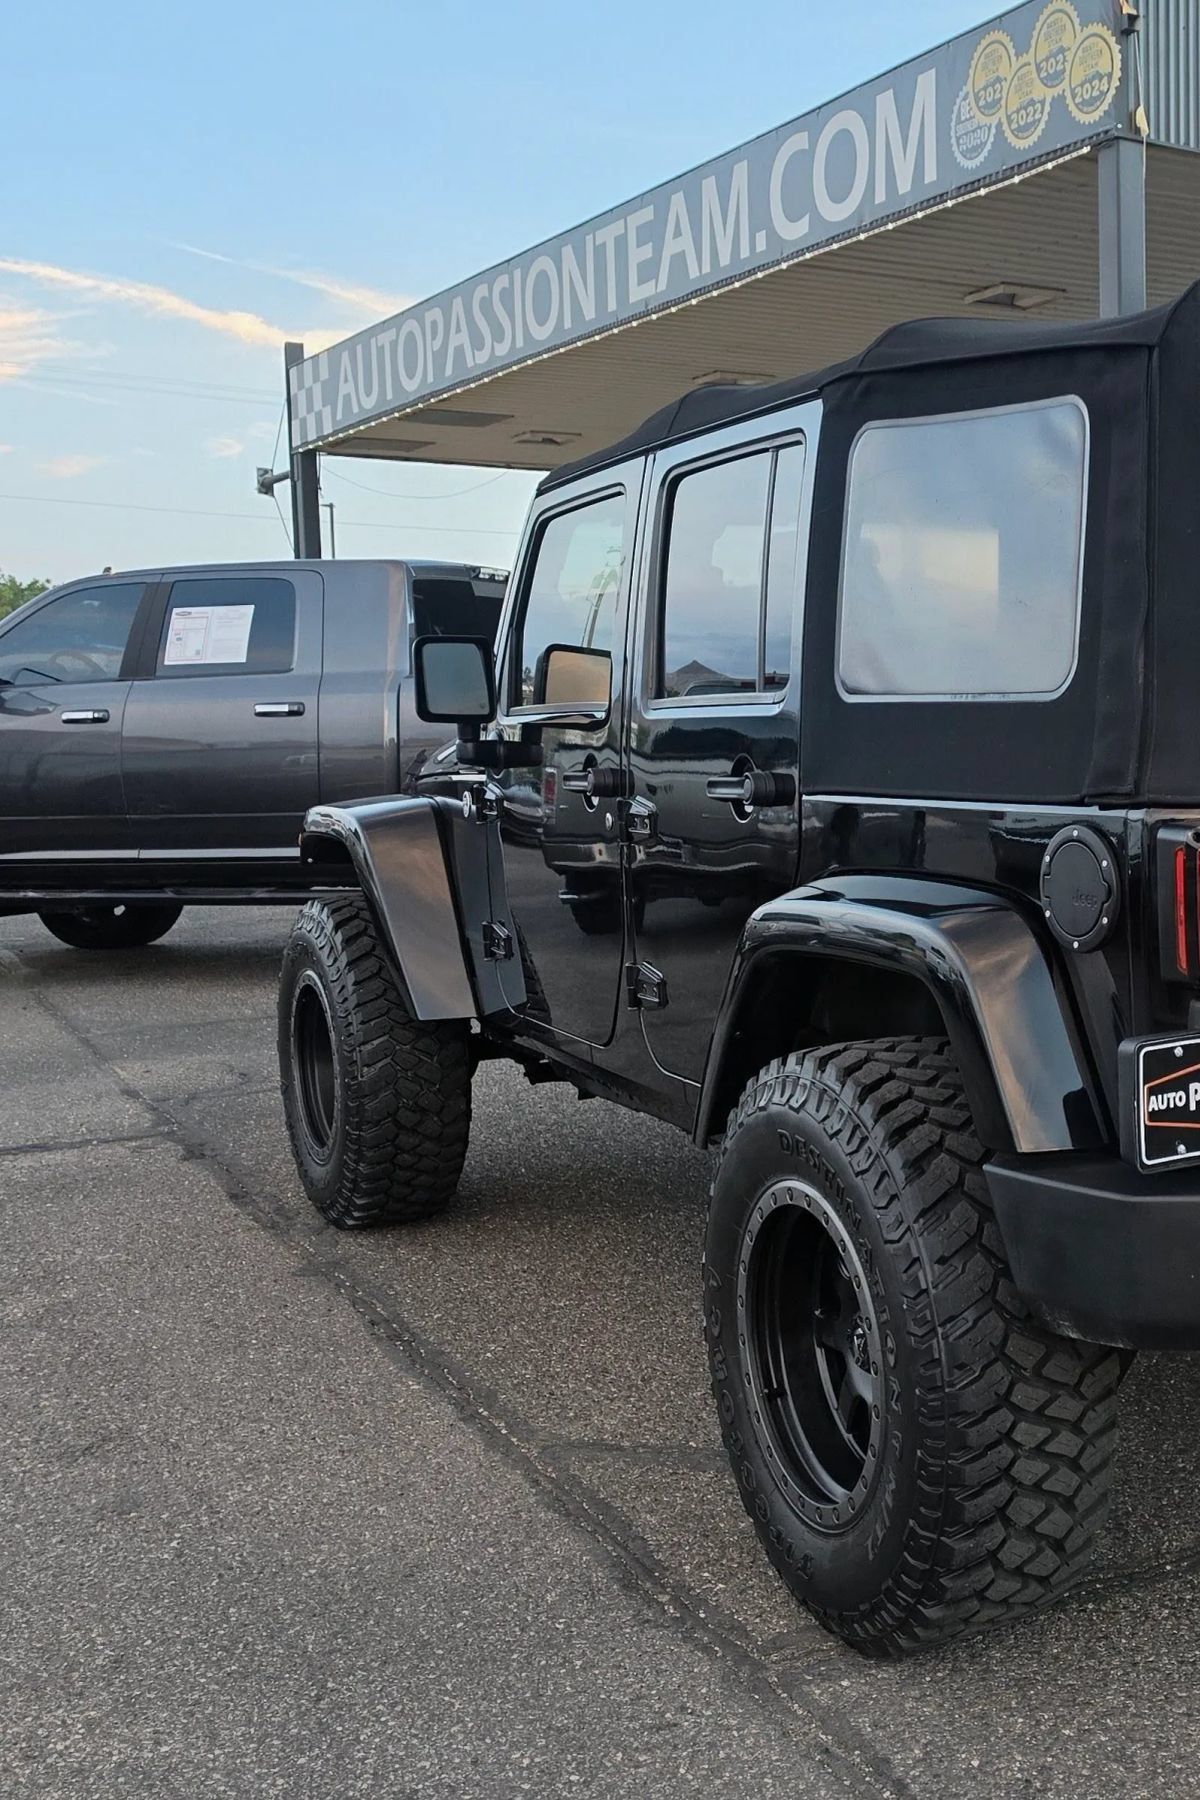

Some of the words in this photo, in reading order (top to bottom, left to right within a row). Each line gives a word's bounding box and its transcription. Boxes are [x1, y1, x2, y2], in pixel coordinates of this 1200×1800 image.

[1040, 53, 1064, 78] 202
[978, 82, 1002, 107] 202
[1075, 75, 1108, 104] 2024
[1010, 102, 1042, 130] 2022
[959, 126, 989, 151] 2020
[335, 67, 938, 421] AUTOPASSIONTEAM.COM
[1148, 1090, 1186, 1112] AUTO
[778, 1129, 903, 1418] DESTINATION
